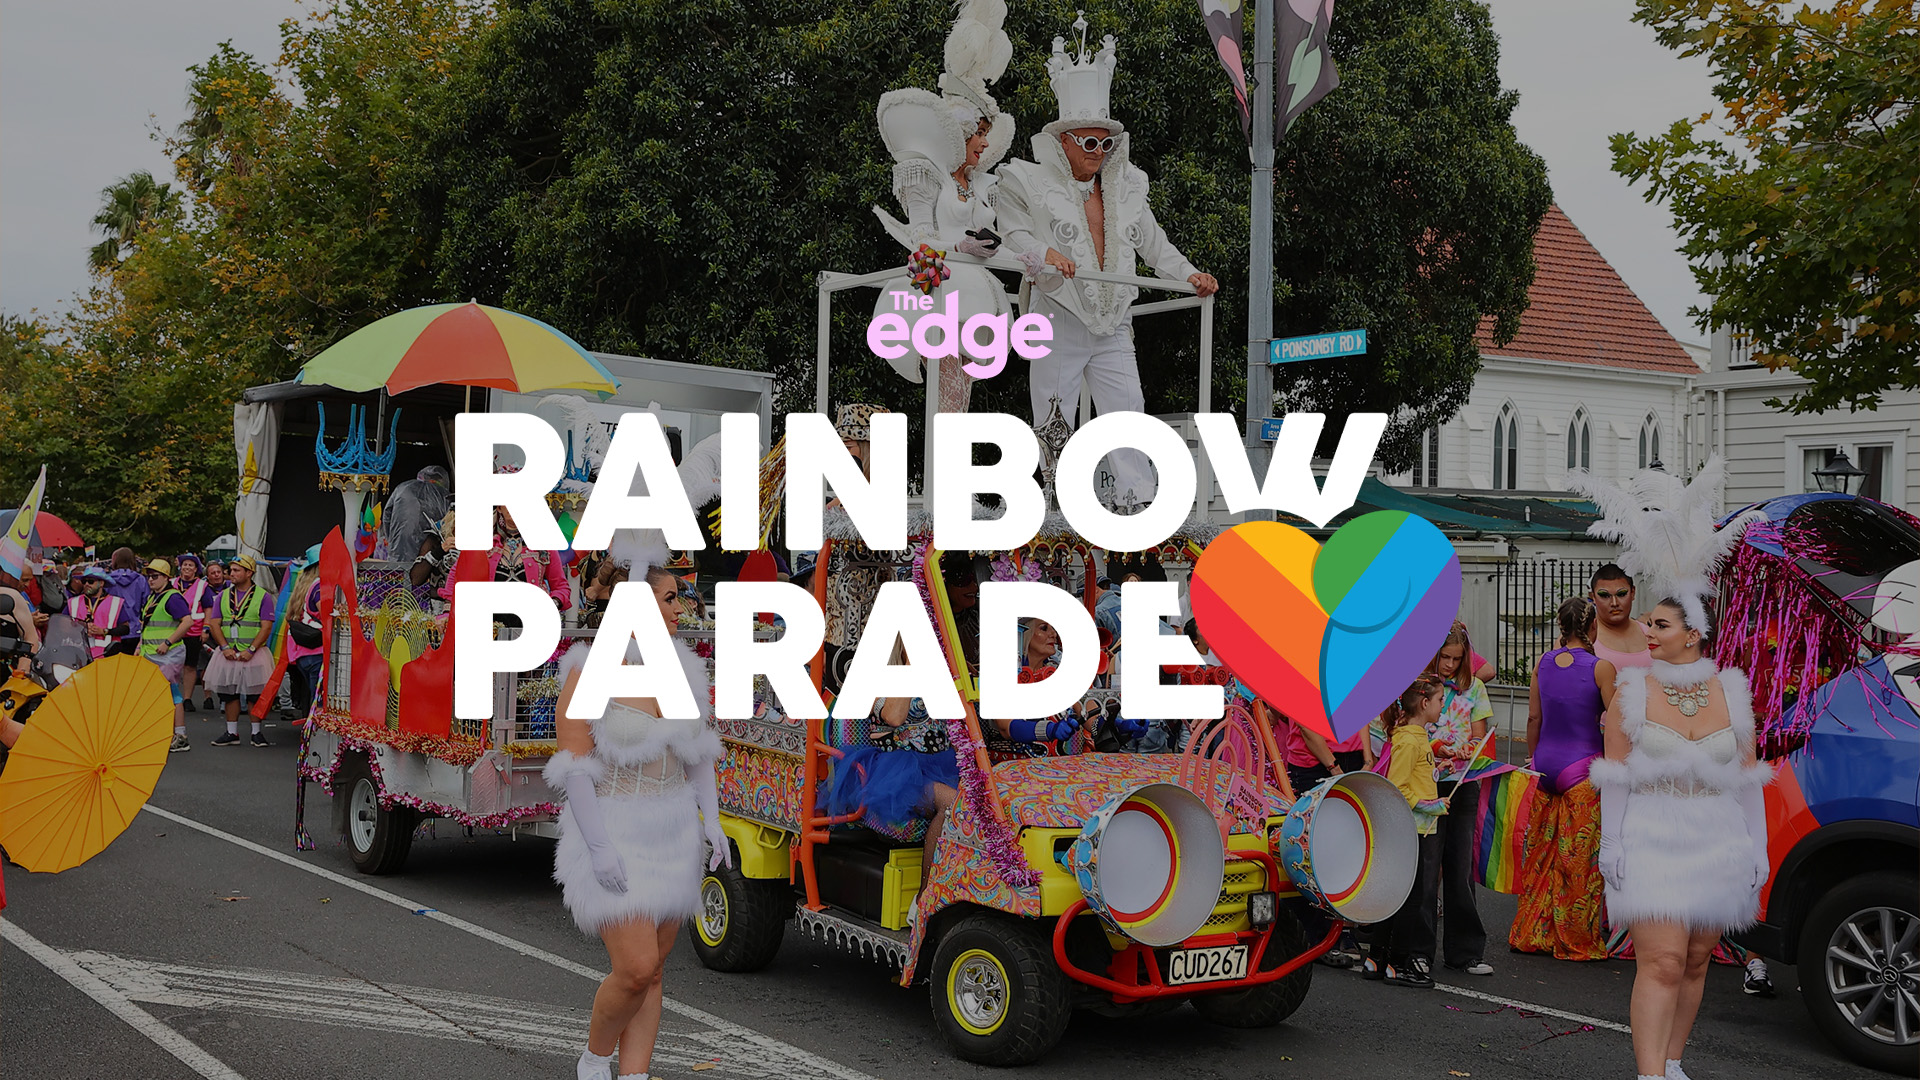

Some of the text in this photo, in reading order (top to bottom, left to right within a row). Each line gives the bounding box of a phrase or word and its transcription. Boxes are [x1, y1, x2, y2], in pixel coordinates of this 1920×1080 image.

[1282, 335, 1354, 358] PONSONBY RD
[1238, 792, 1258, 812] PARADE
[1240, 785, 1263, 808] RAINBOW
[1171, 948, 1246, 980] CUD267
